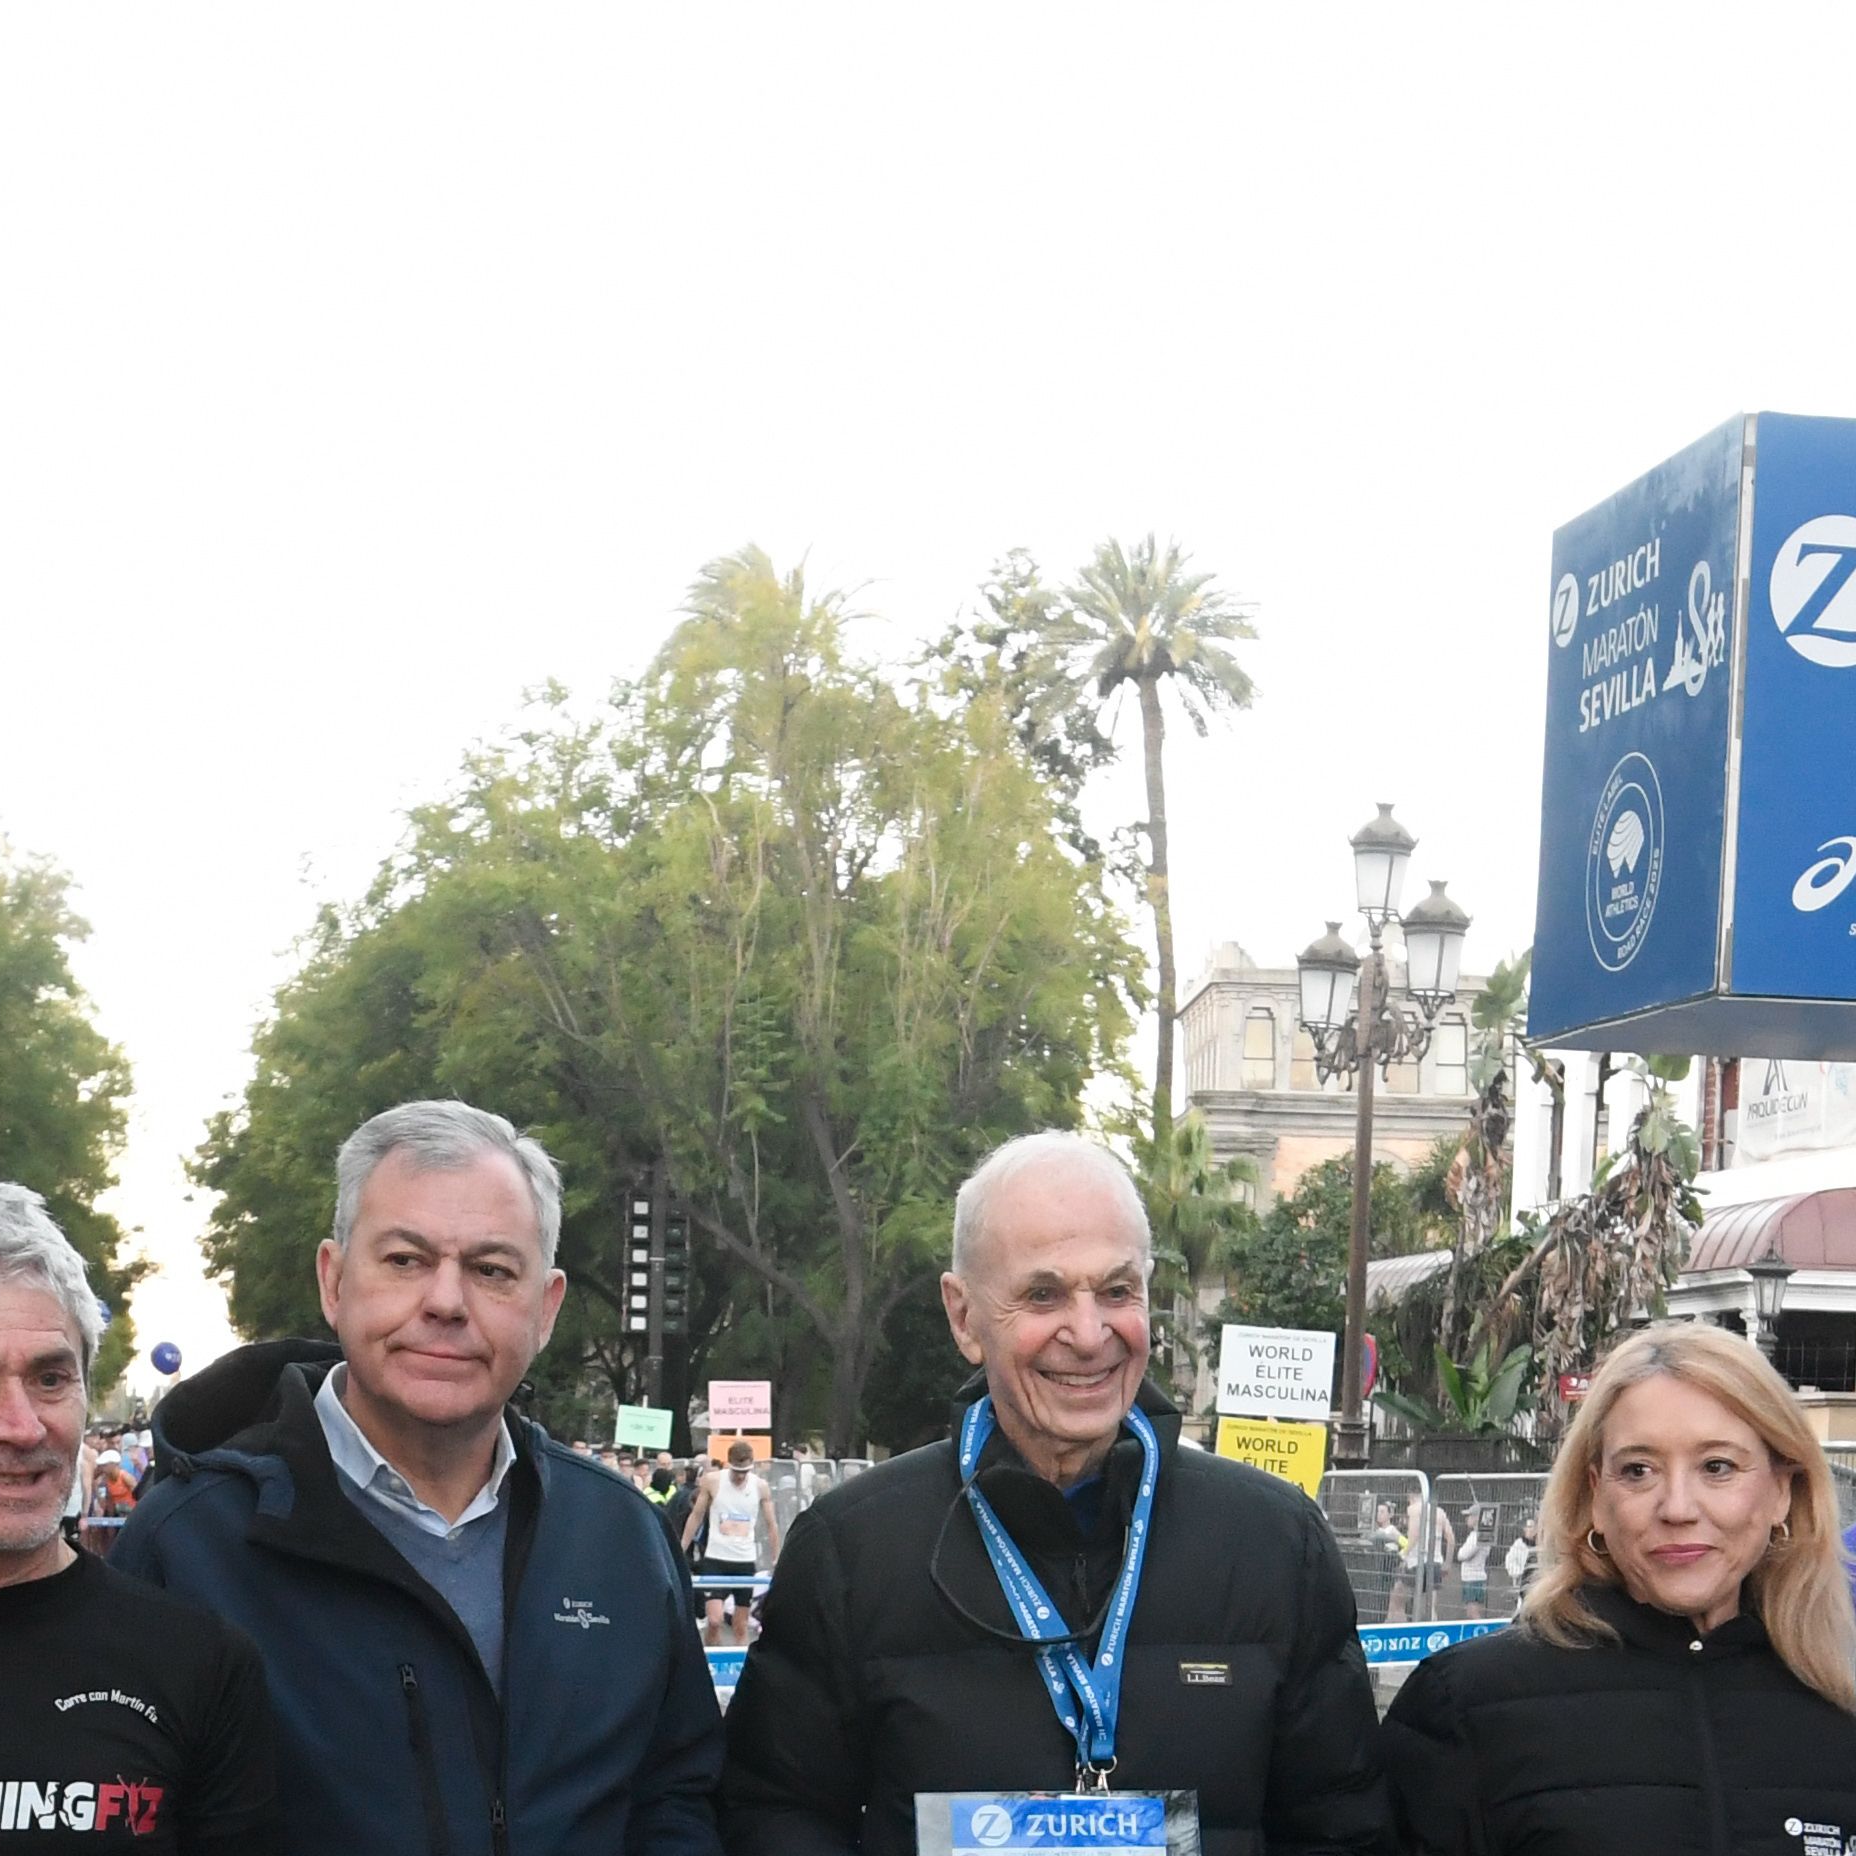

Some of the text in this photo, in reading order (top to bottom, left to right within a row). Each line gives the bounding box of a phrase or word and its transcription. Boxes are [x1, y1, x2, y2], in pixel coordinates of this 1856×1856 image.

[1586, 538, 1661, 616] ZURICH
[1582, 602, 1659, 680] MARATÓN
[1579, 657, 1656, 733] SEVILLA
[1248, 1344, 1313, 1361] WORLD
[1226, 1383, 1329, 1403] MASCULINA
[1236, 1436, 1298, 1455] WORLD
[54, 1693, 88, 1711] Corre
[88, 1691, 109, 1702] con
[1026, 1811, 1139, 1838] ZURICH
